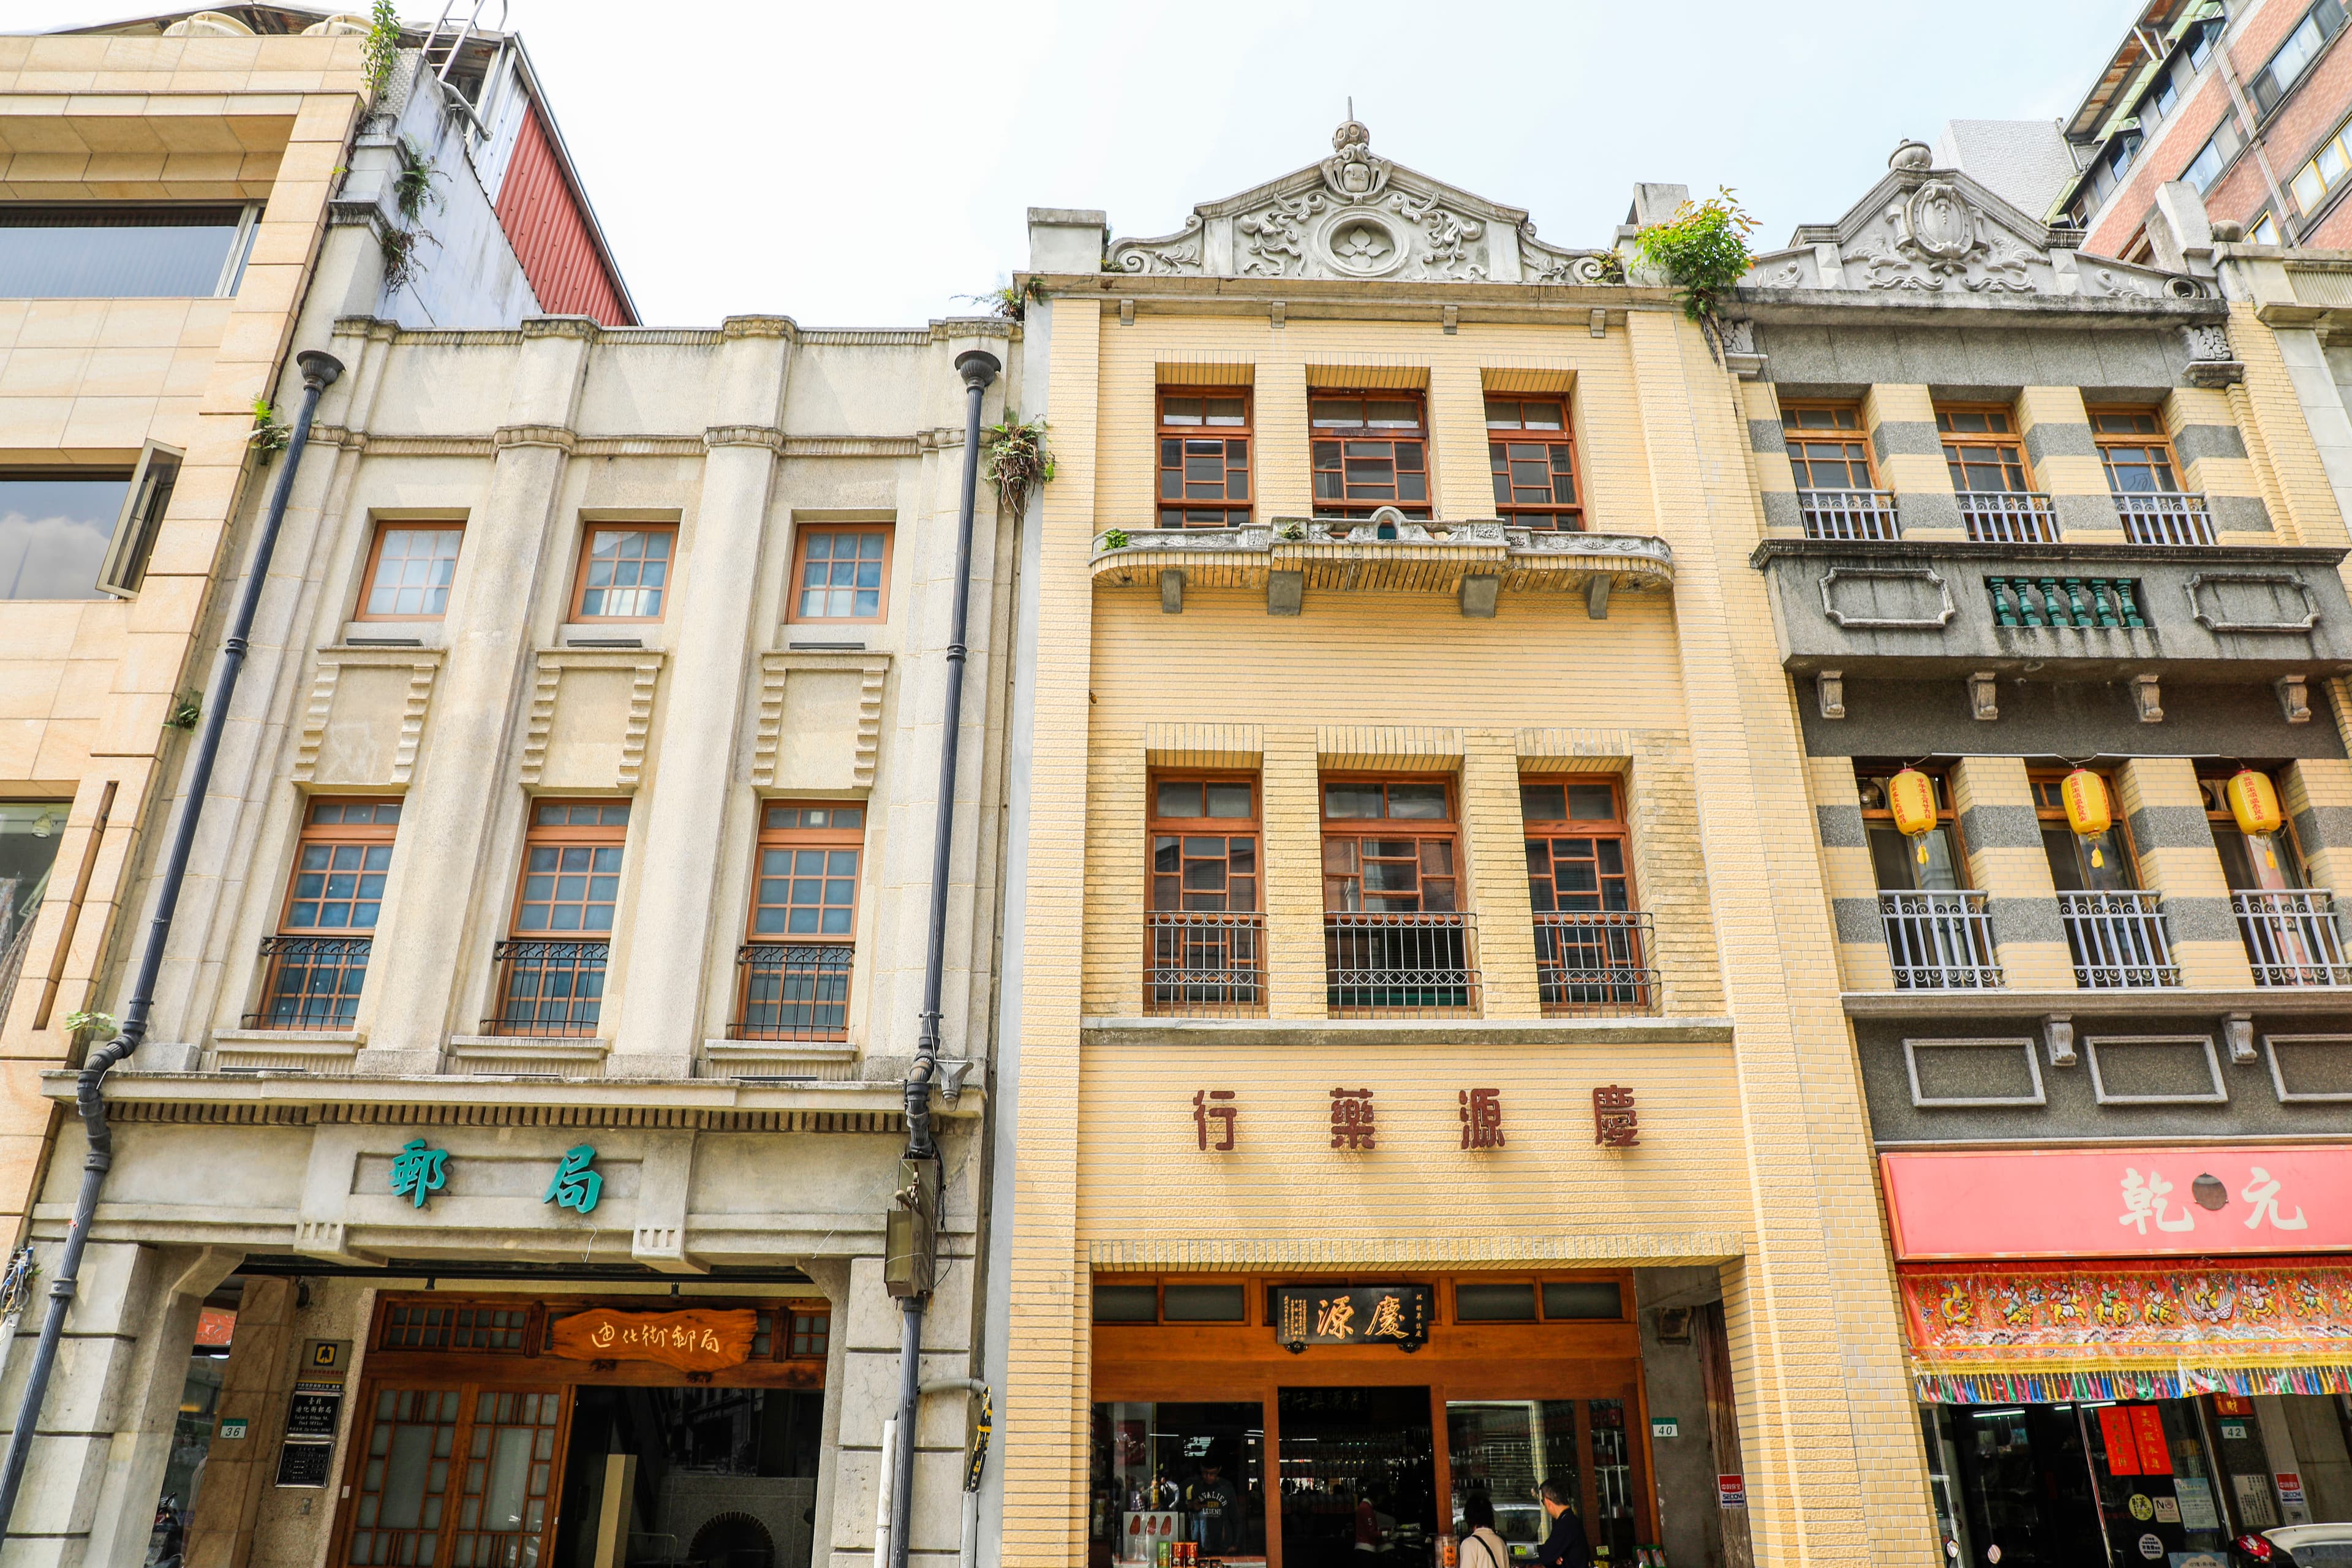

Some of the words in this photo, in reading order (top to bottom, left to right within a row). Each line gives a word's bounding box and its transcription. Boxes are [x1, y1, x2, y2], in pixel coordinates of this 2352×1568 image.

[388, 1138, 603, 1215] 郵局
[2119, 1166, 2309, 1235] 乾元
[592, 1322, 720, 1353] 迪化街郵局
[225, 1427, 241, 1437] 36
[1659, 1426, 1673, 1435] 40
[2228, 1428, 2241, 1437] 42
